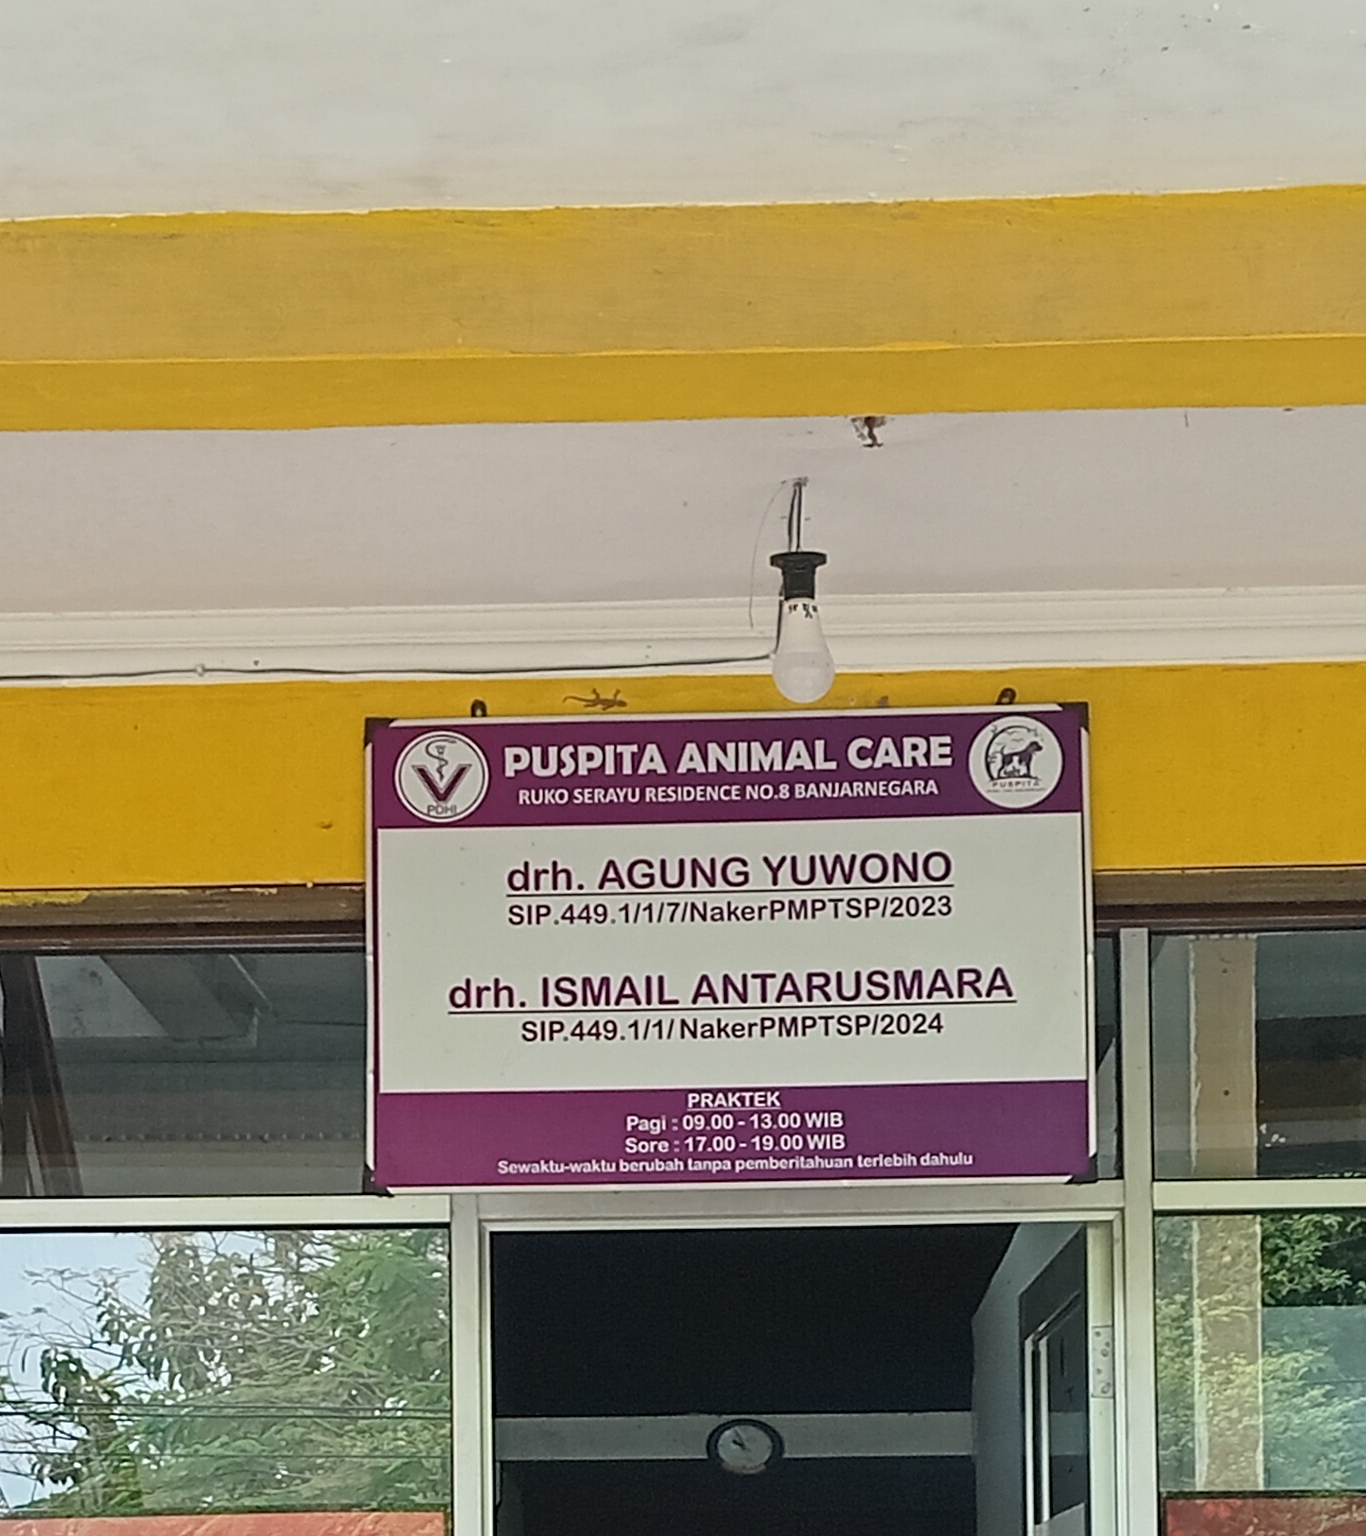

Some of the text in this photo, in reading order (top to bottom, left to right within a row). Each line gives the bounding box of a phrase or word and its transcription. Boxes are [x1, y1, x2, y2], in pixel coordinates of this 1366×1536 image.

[503, 735, 954, 779] PUSPITA ANIMAL CARE
[518, 780, 939, 805] RUKO SERAYU RESIDENCE NO.8 BANJARNEGARA
[991, 780, 1040, 788] PUSPITA
[427, 804, 457, 816] PDHI
[507, 851, 953, 892] drh. AGUNG YUWONO
[508, 896, 953, 926] SIP.449.1/1/7/NakerPMPTSP/2023
[448, 966, 1014, 1008] drh. ISMAIL ANTARUSMARA
[687, 1091, 781, 1109] PRAKTEK
[626, 1115, 666, 1134] Pagi
[682, 1114, 734, 1131] 09.00
[749, 1113, 801, 1130] 13.00
[804, 1111, 844, 1128] WIB
[625, 1137, 670, 1154] Sore
[684, 1136, 736, 1152] 17.00
[751, 1135, 803, 1152] 19.00
[806, 1134, 846, 1150] WIB
[497, 1152, 973, 1174] Sewaktu-waktu berubah tanpa pemberitahuan terlebih dahulu
